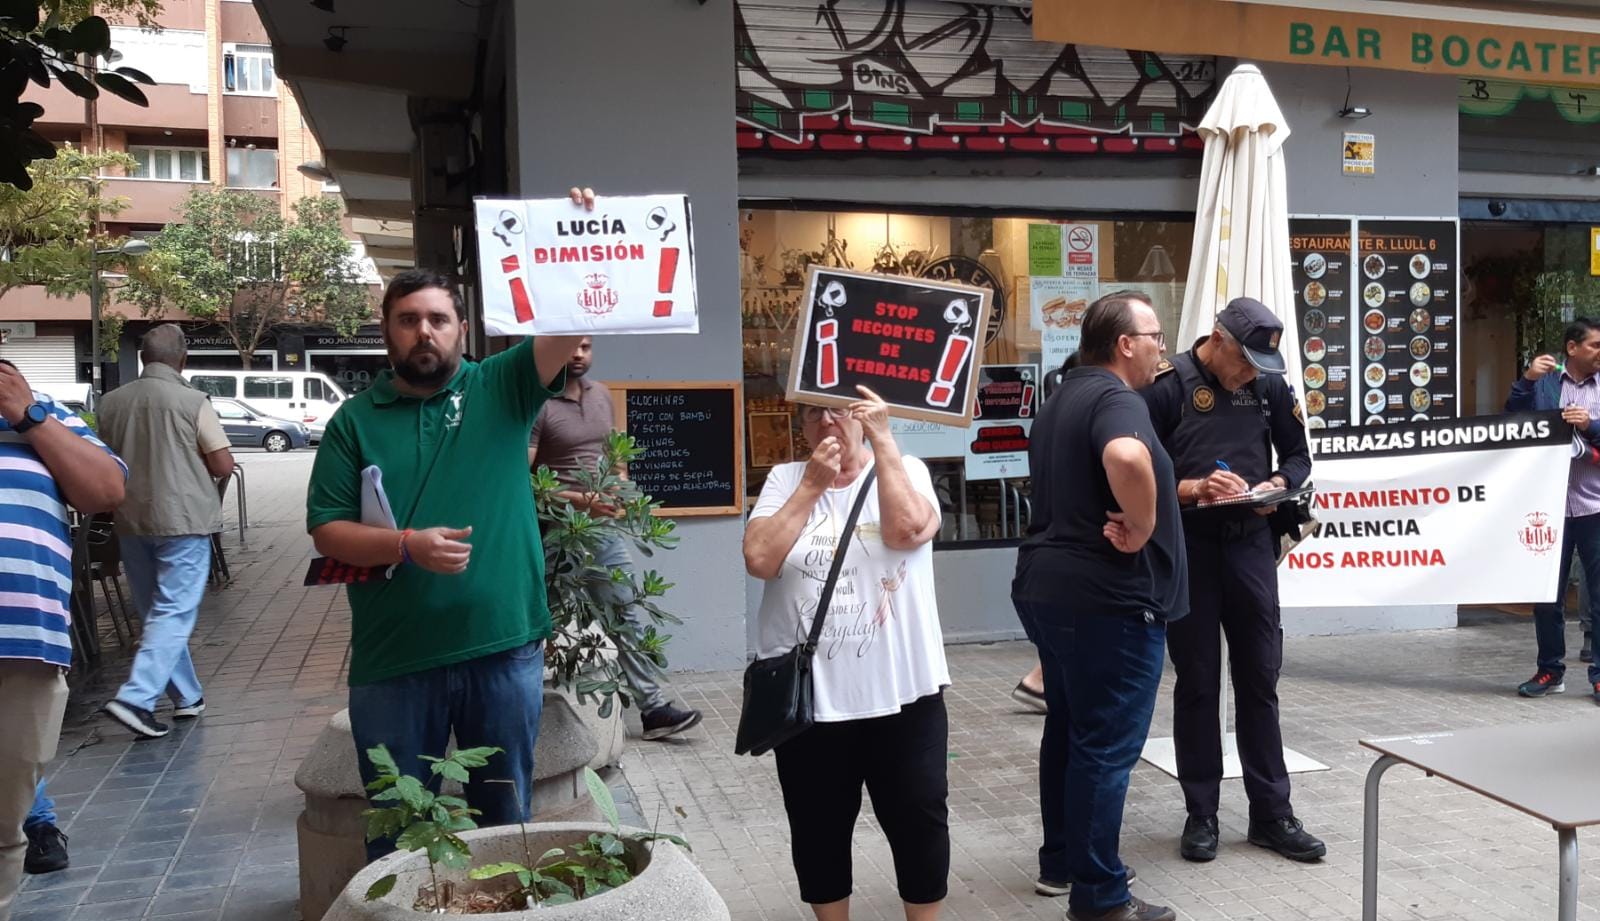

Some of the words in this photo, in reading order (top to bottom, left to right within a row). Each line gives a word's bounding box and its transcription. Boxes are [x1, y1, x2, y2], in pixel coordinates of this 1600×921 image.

[1289, 21, 1382, 60] BAR
[856, 63, 910, 95] BTNS
[556, 214, 627, 237] LUCÍA
[534, 240, 645, 264] DIMISIÓN
[1390, 238, 1427, 251] LLULL
[1429, 239, 1437, 251] 6
[875, 302, 919, 320] STOP
[852, 319, 936, 344] RECORTES
[879, 342, 900, 358] DE
[845, 357, 932, 384] TERRAZAS
[636, 438, 676, 448] ELLINAS
[1310, 431, 1416, 455] TERRAZAS
[1420, 419, 1551, 448] HONDURAS
[637, 484, 660, 493] OLLO
[1311, 486, 1451, 510] NTAMIENTO
[1457, 484, 1486, 503] DE
[1311, 518, 1421, 540] VALENCIA
[1287, 551, 1336, 570] NOS
[1340, 548, 1447, 569] ARRUINA
